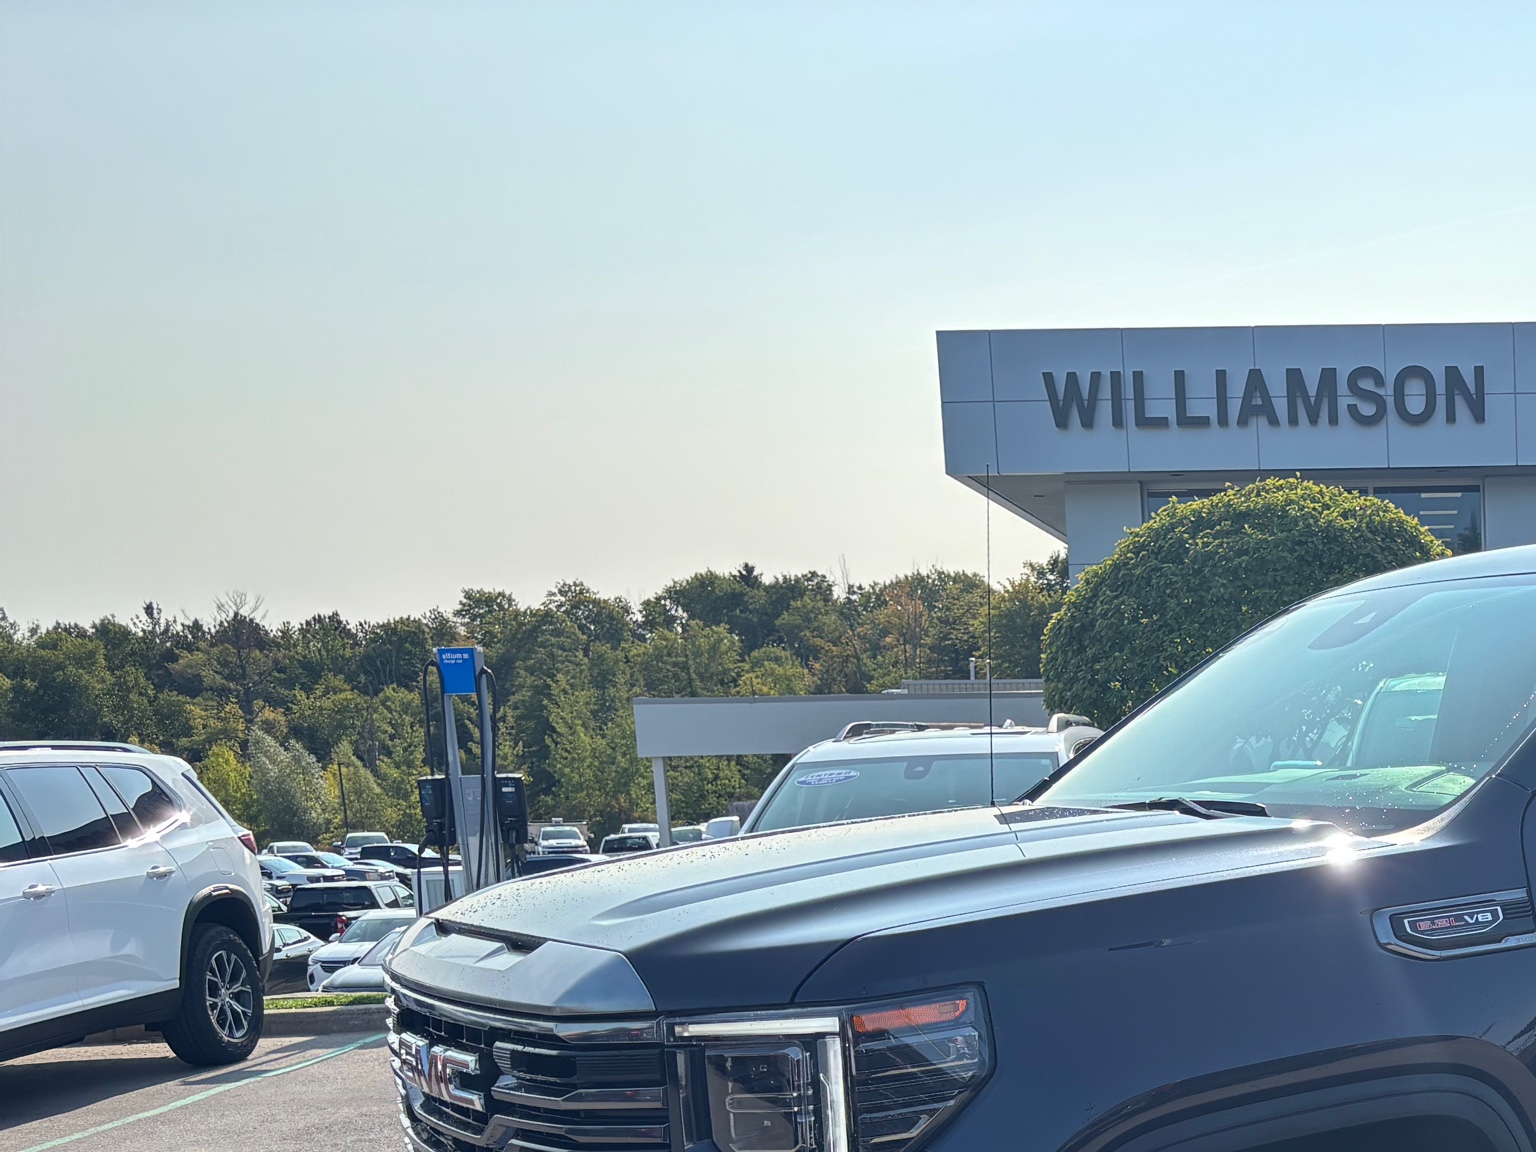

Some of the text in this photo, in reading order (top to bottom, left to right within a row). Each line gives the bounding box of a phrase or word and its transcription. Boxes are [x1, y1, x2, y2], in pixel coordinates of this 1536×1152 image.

[1041, 364, 1486, 429] WILLIAMSON
[1463, 912, 1493, 924] V8
[399, 1032, 486, 1112] GMC
